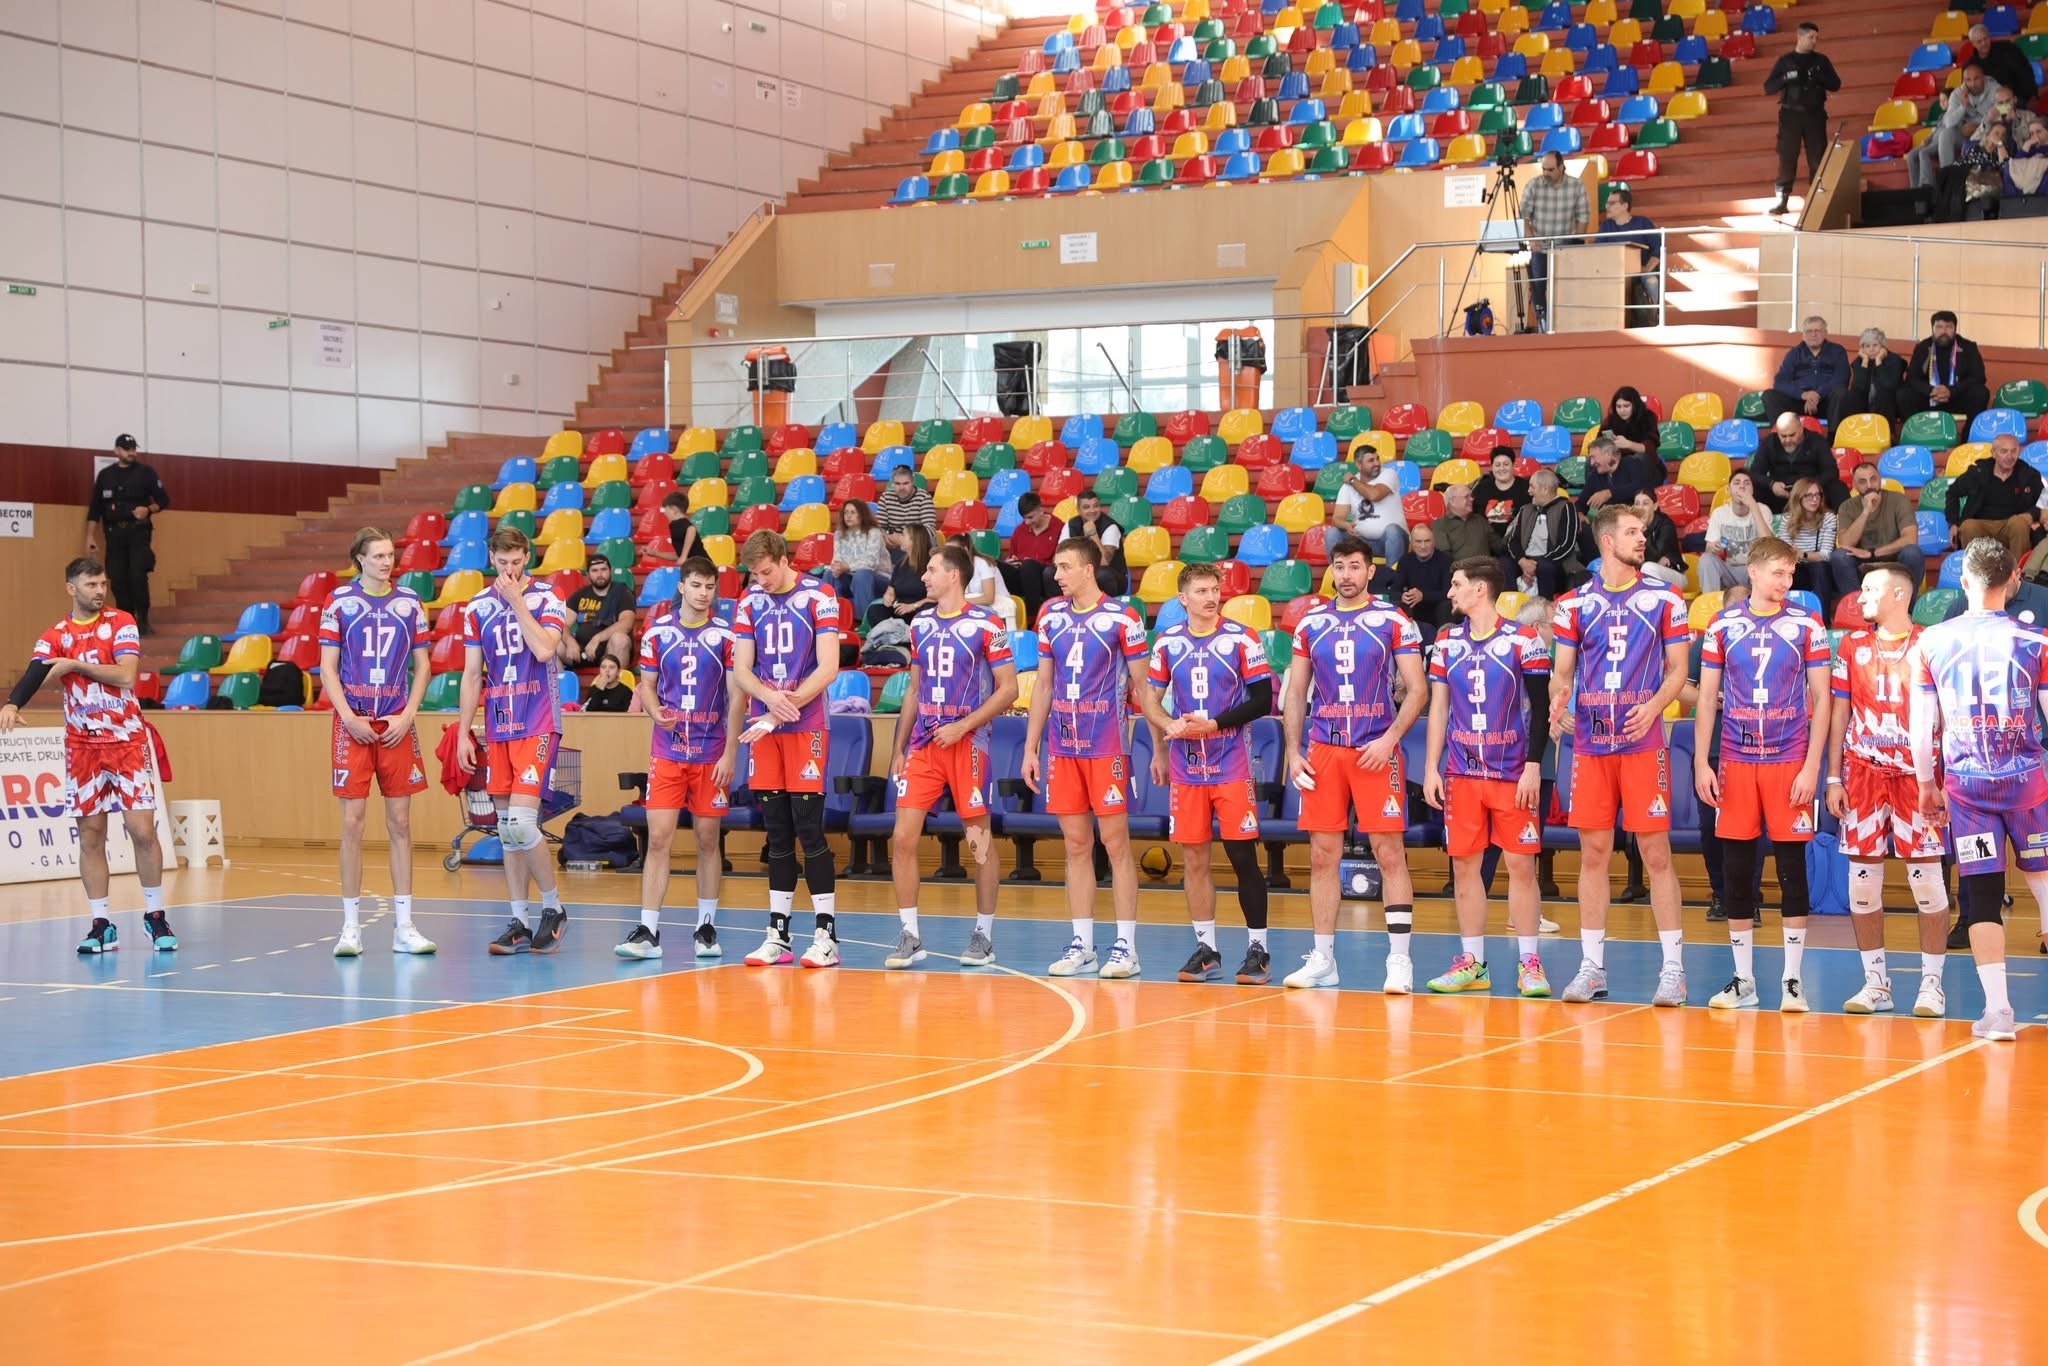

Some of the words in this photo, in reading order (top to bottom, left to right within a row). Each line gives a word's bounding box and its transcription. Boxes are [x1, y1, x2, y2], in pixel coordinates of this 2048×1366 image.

[11, 521, 19, 533] C
[362, 626, 396, 657] 17
[764, 621, 793, 655] 10
[1606, 625, 1628, 661] 5
[680, 655, 697, 685] 2
[926, 645, 955, 677] 18
[1065, 641, 1085, 674] 4
[1334, 639, 1355, 674] 9
[1751, 647, 1772, 680] 7
[1190, 666, 1209, 699] 8
[1467, 669, 1486, 703] 3
[1875, 673, 1901, 702] 11
[1958, 661, 2007, 705] 12
[34, 736, 62, 746] CIVILE
[333, 769, 349, 788] 17
[1657, 749, 1667, 792] SPCF
